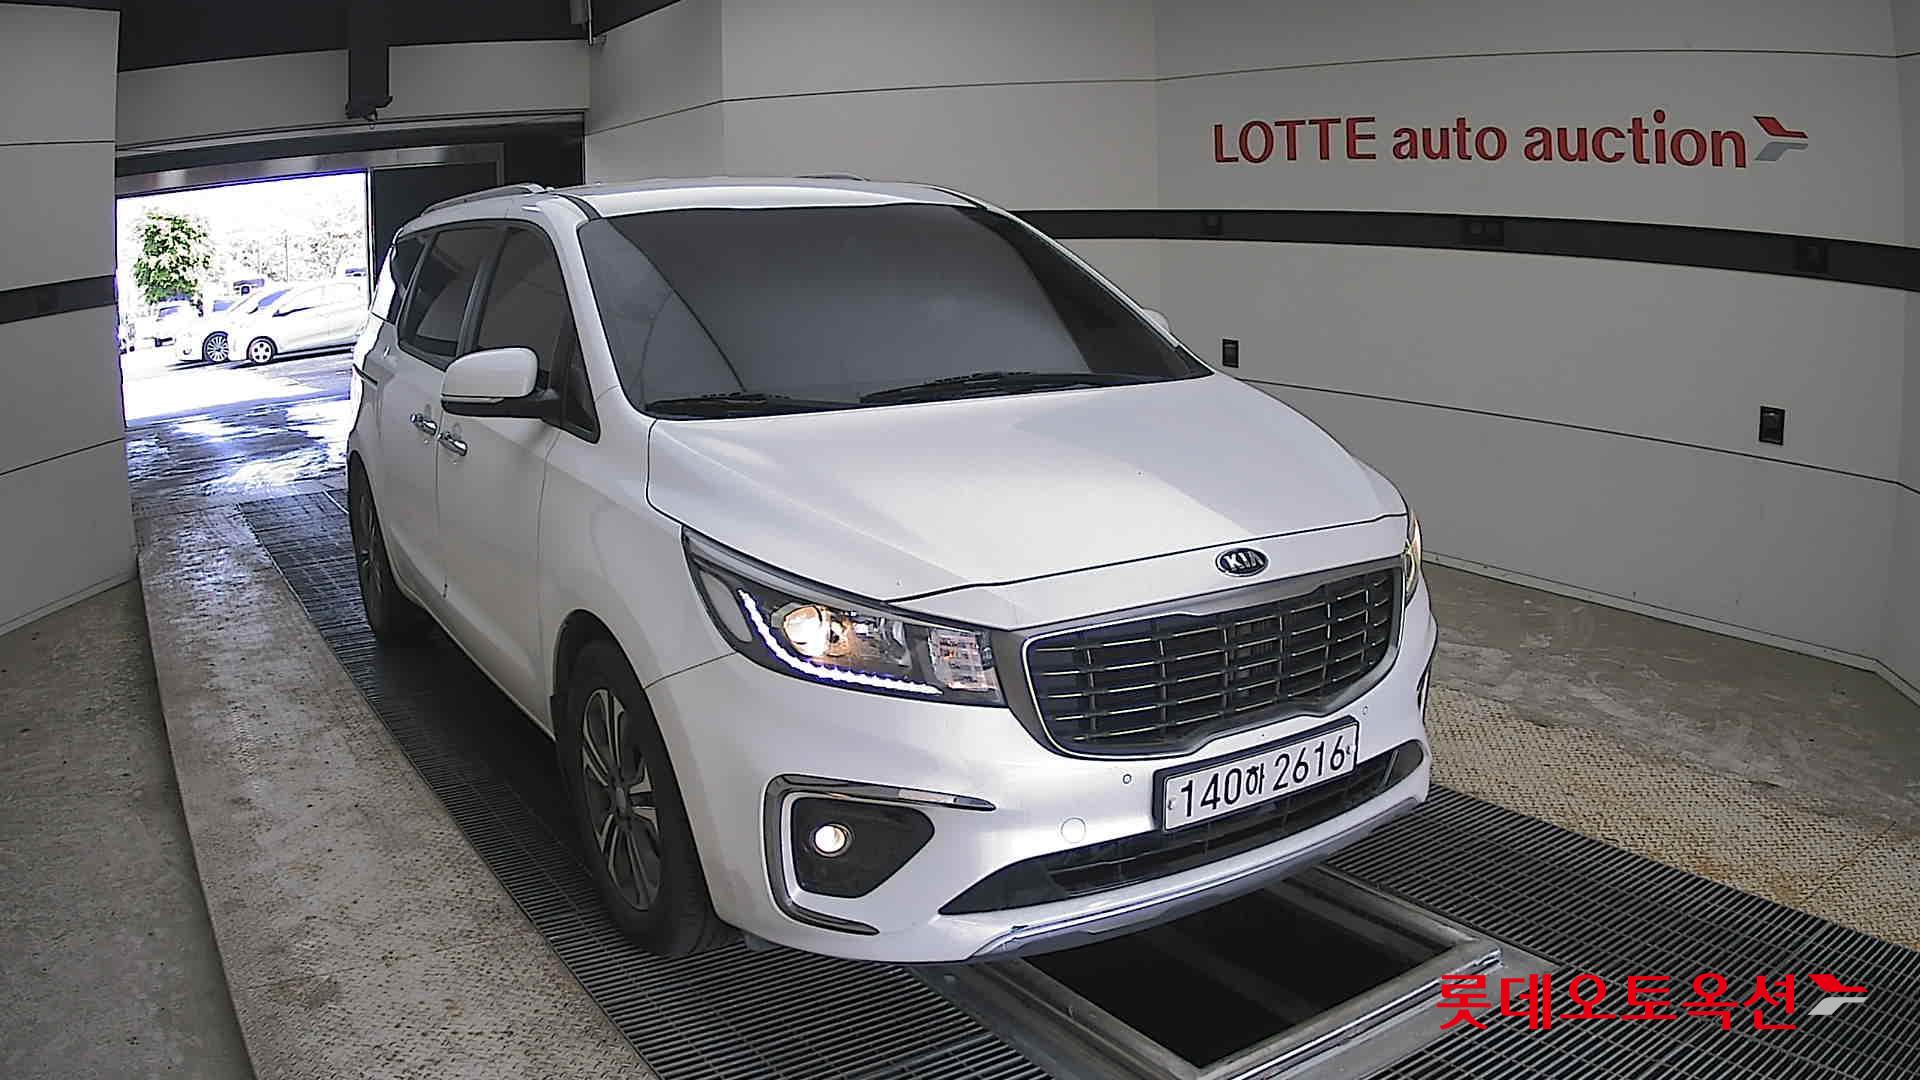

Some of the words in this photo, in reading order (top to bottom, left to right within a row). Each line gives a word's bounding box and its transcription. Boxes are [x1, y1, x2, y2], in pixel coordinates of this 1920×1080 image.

[1212, 116, 1377, 163] LOTTE
[1392, 117, 1508, 161] auto
[1523, 109, 1747, 168] auction
[1223, 551, 1264, 570] KIA
[1181, 763, 1265, 817] 140하
[1273, 735, 1345, 791] 2616
